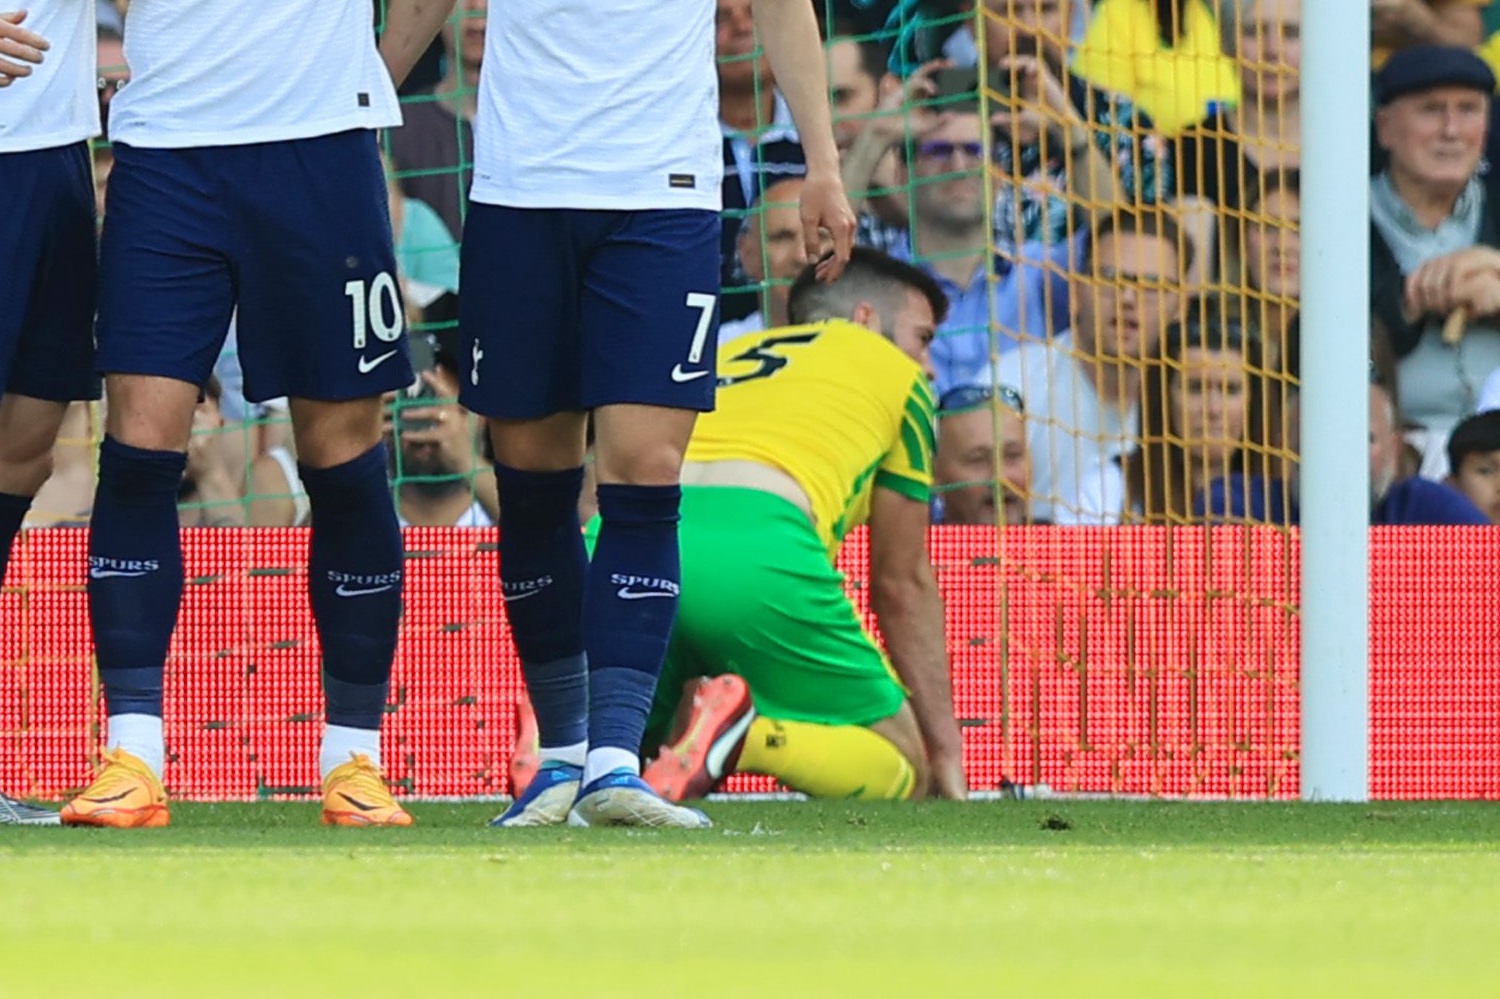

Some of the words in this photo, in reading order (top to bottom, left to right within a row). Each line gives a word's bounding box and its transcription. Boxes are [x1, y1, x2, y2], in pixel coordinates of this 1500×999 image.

[345, 271, 403, 349] 10
[686, 292, 717, 363] 7
[88, 555, 159, 571] SPURS
[327, 570, 401, 584] SPURS
